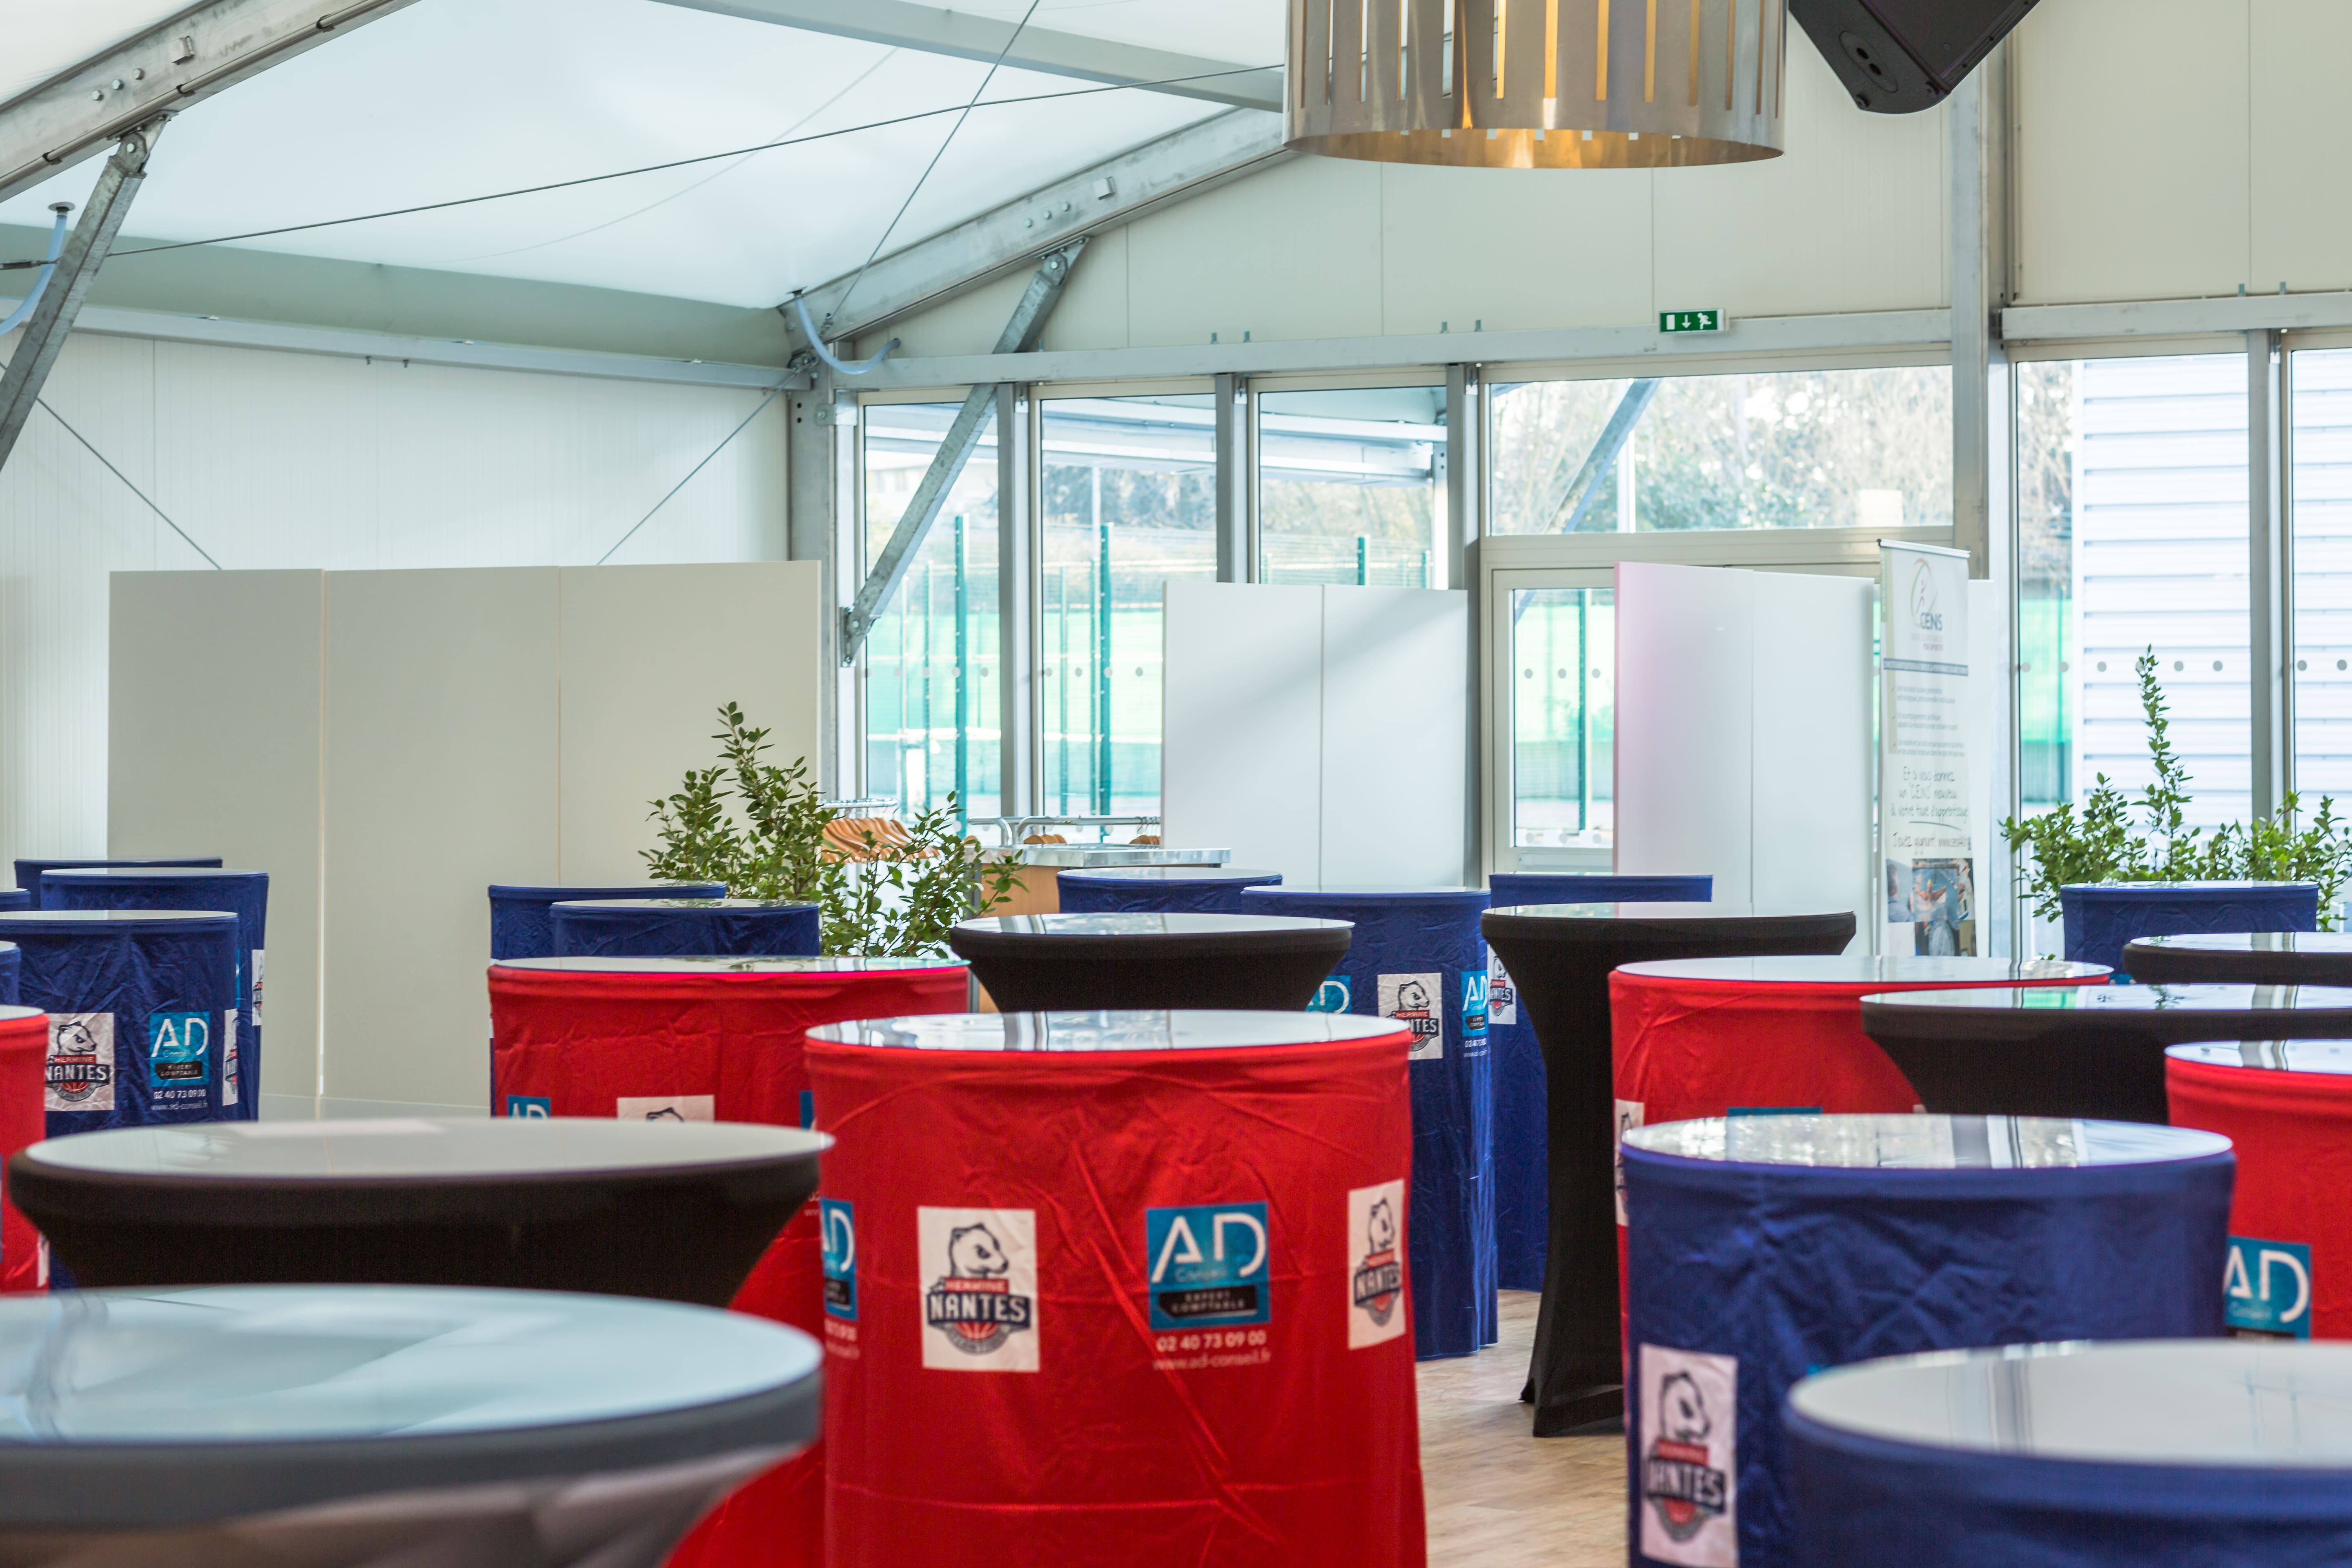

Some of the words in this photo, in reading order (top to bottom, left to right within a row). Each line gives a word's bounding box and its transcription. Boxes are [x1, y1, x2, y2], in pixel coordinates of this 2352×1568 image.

[1920, 612, 1942, 631] CENS
[1307, 981, 1350, 1015] D
[151, 1018, 209, 1058] AD
[154, 1091, 163, 1099] 02
[164, 1090, 176, 1098] 40
[177, 1090, 187, 1098] 73
[1151, 1212, 1266, 1283] AD
[931, 1294, 1025, 1323] NANTES
[1156, 1336, 1177, 1352] 02
[1180, 1334, 1201, 1350] 40
[1203, 1333, 1223, 1348] 73
[1225, 1331, 1246, 1347] 09
[1247, 1329, 1266, 1345] 00
